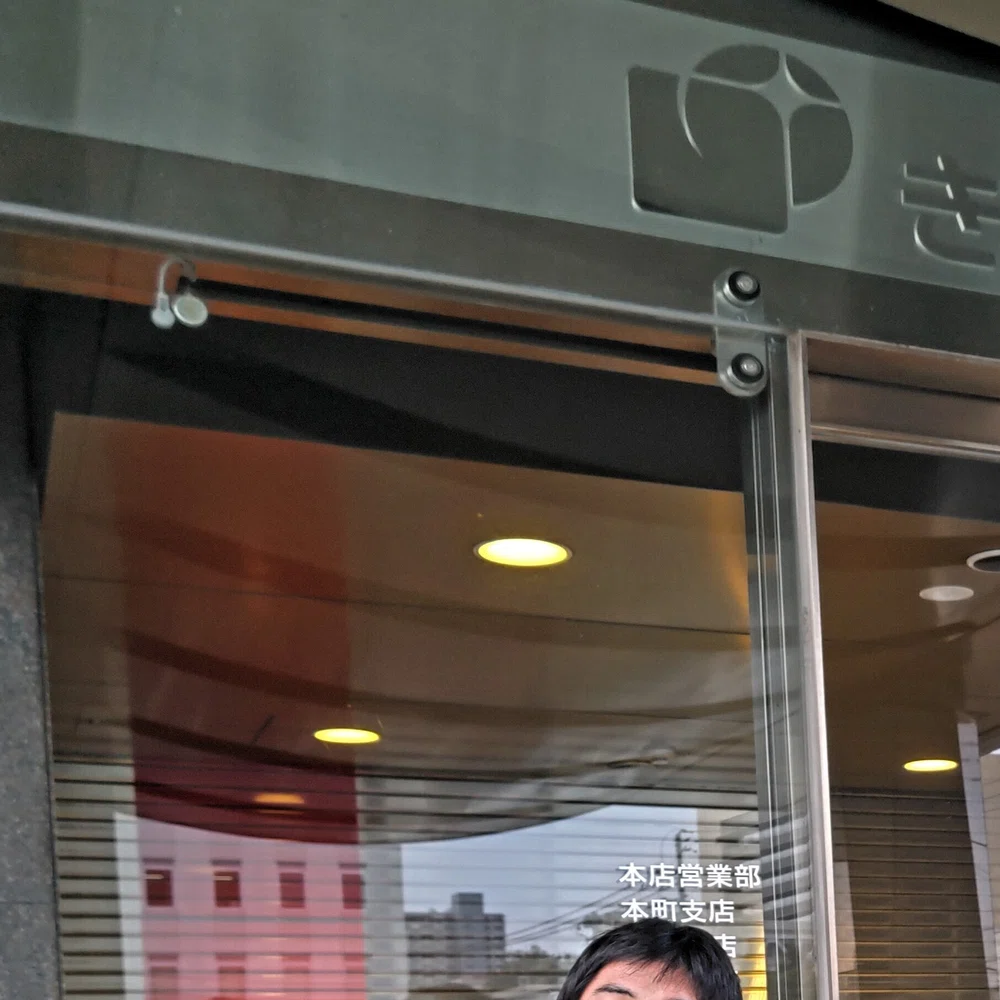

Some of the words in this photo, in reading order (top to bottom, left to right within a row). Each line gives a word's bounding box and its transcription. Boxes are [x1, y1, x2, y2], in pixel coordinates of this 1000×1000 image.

[618, 863, 761, 889] 本店営業部
[621, 899, 735, 924] 本町支店
